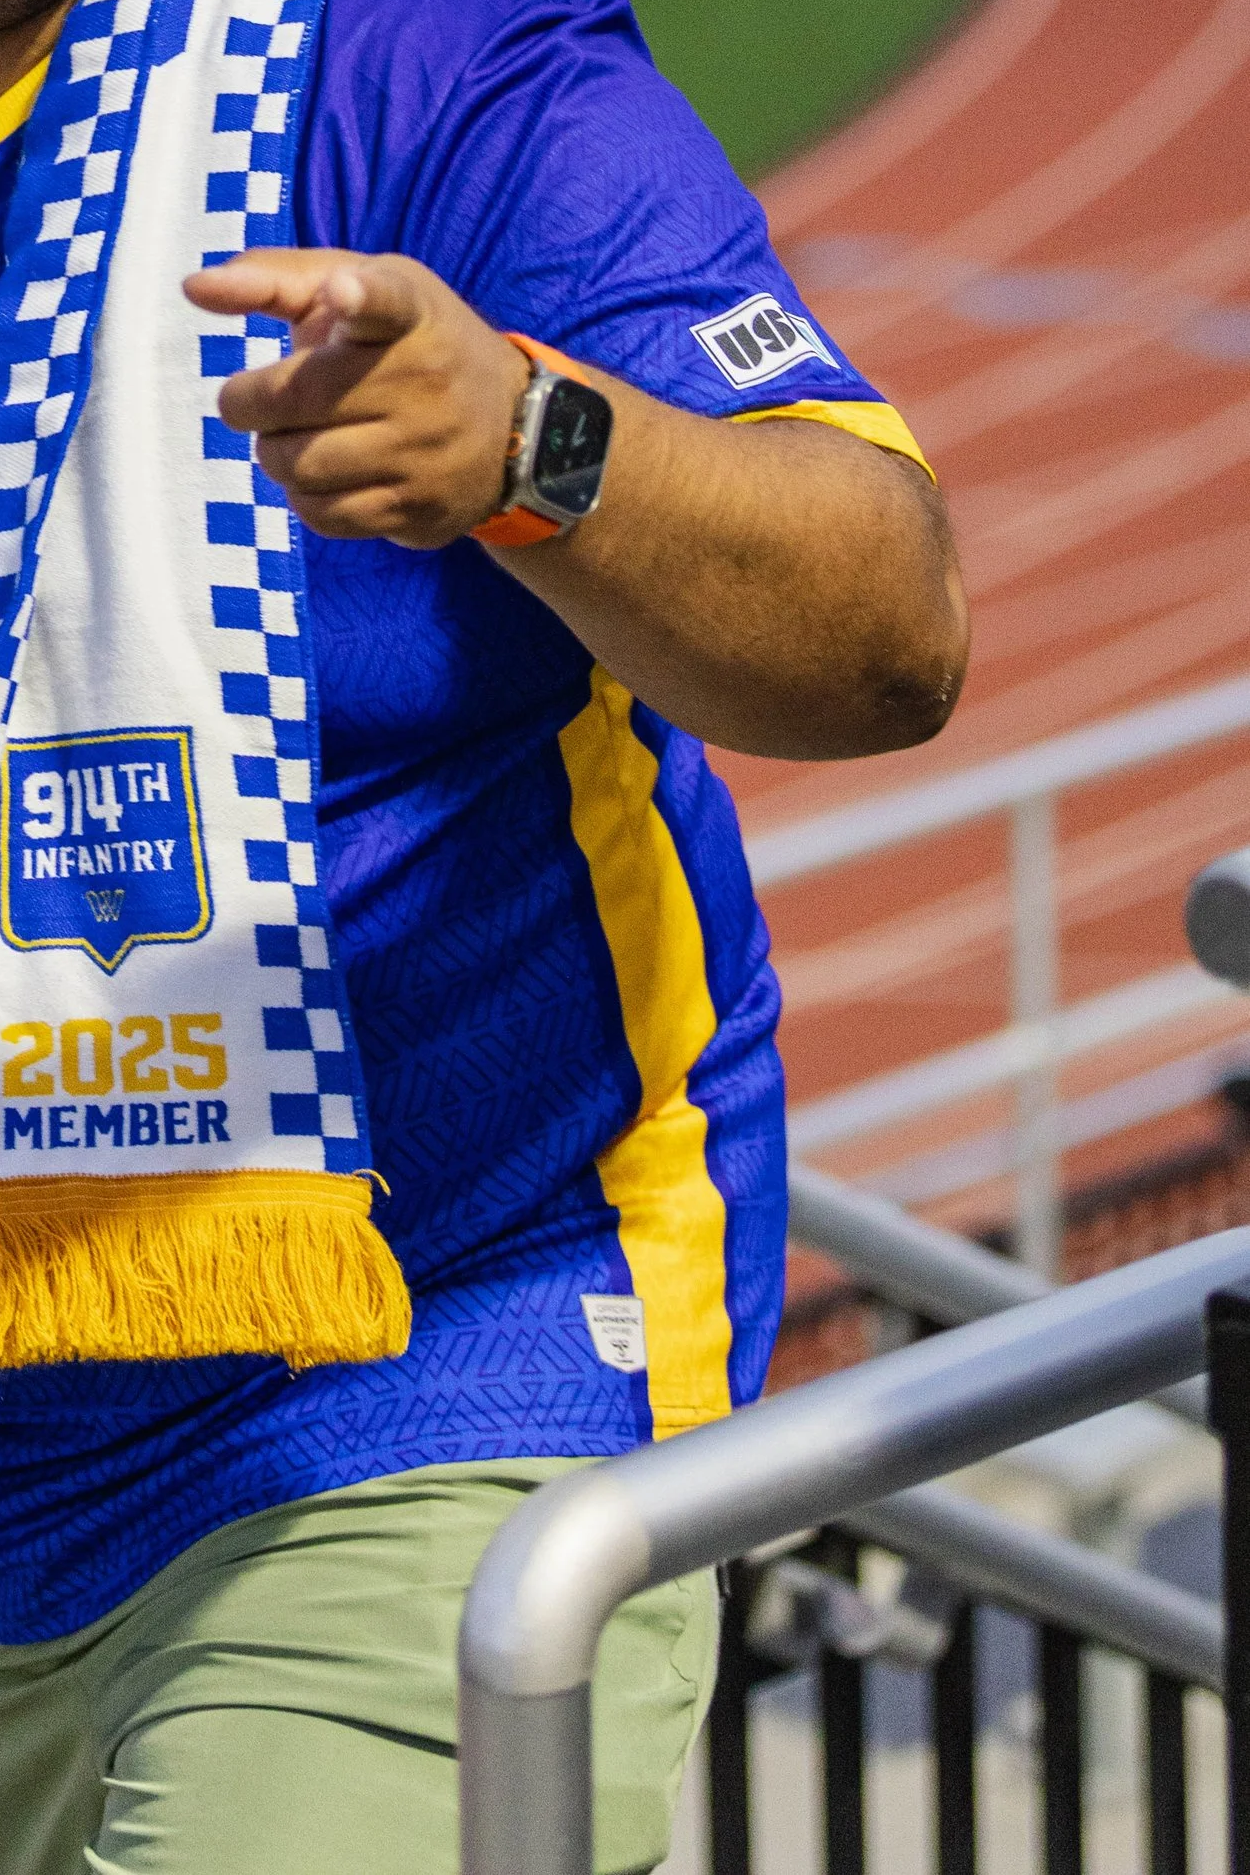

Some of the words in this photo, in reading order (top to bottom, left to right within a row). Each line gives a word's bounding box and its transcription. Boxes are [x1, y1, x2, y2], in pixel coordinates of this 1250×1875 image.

[22, 839, 176, 879] INFANTRY
[0, 1012, 228, 1097] 2025
[3, 1100, 231, 1150] MEMBER
